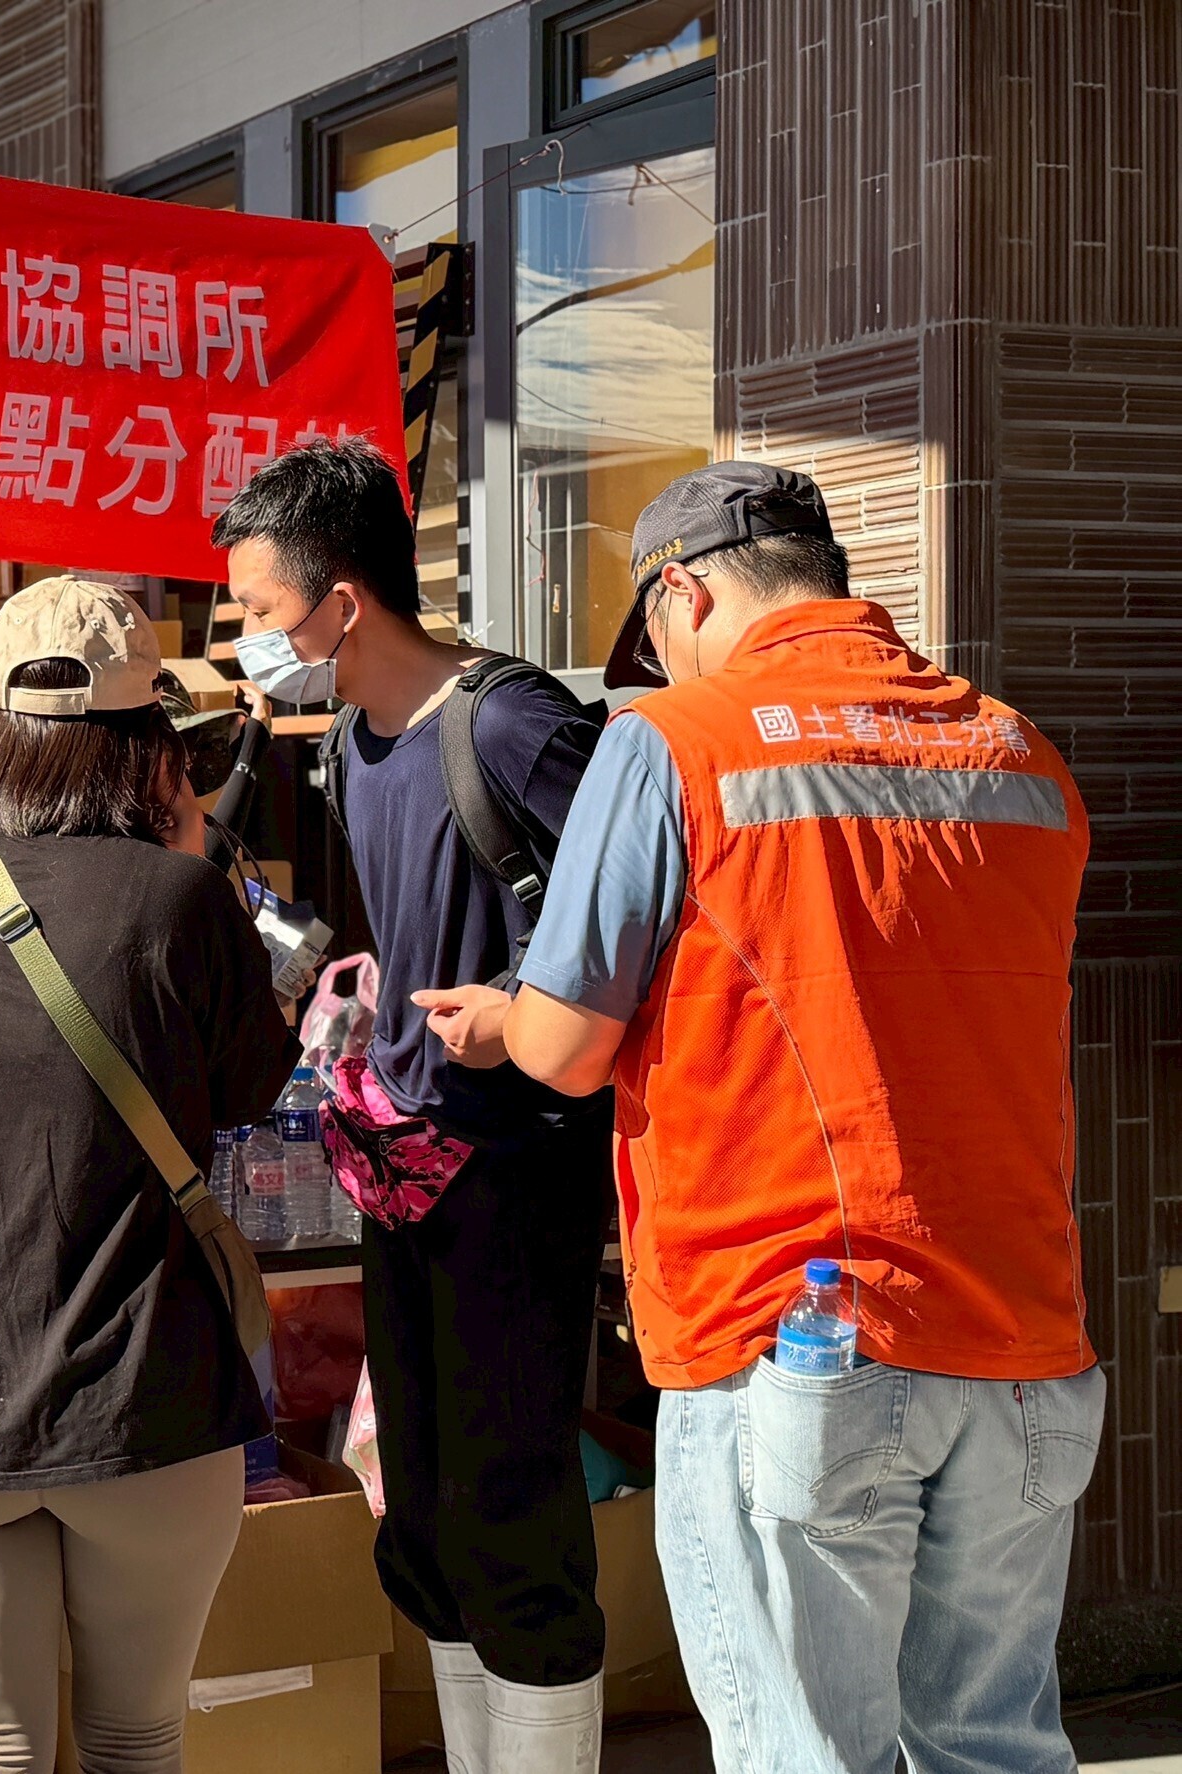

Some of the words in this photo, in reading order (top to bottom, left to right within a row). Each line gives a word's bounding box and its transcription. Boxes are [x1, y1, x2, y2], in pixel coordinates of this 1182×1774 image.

[752, 703, 1031, 757] 國土署北工分署
